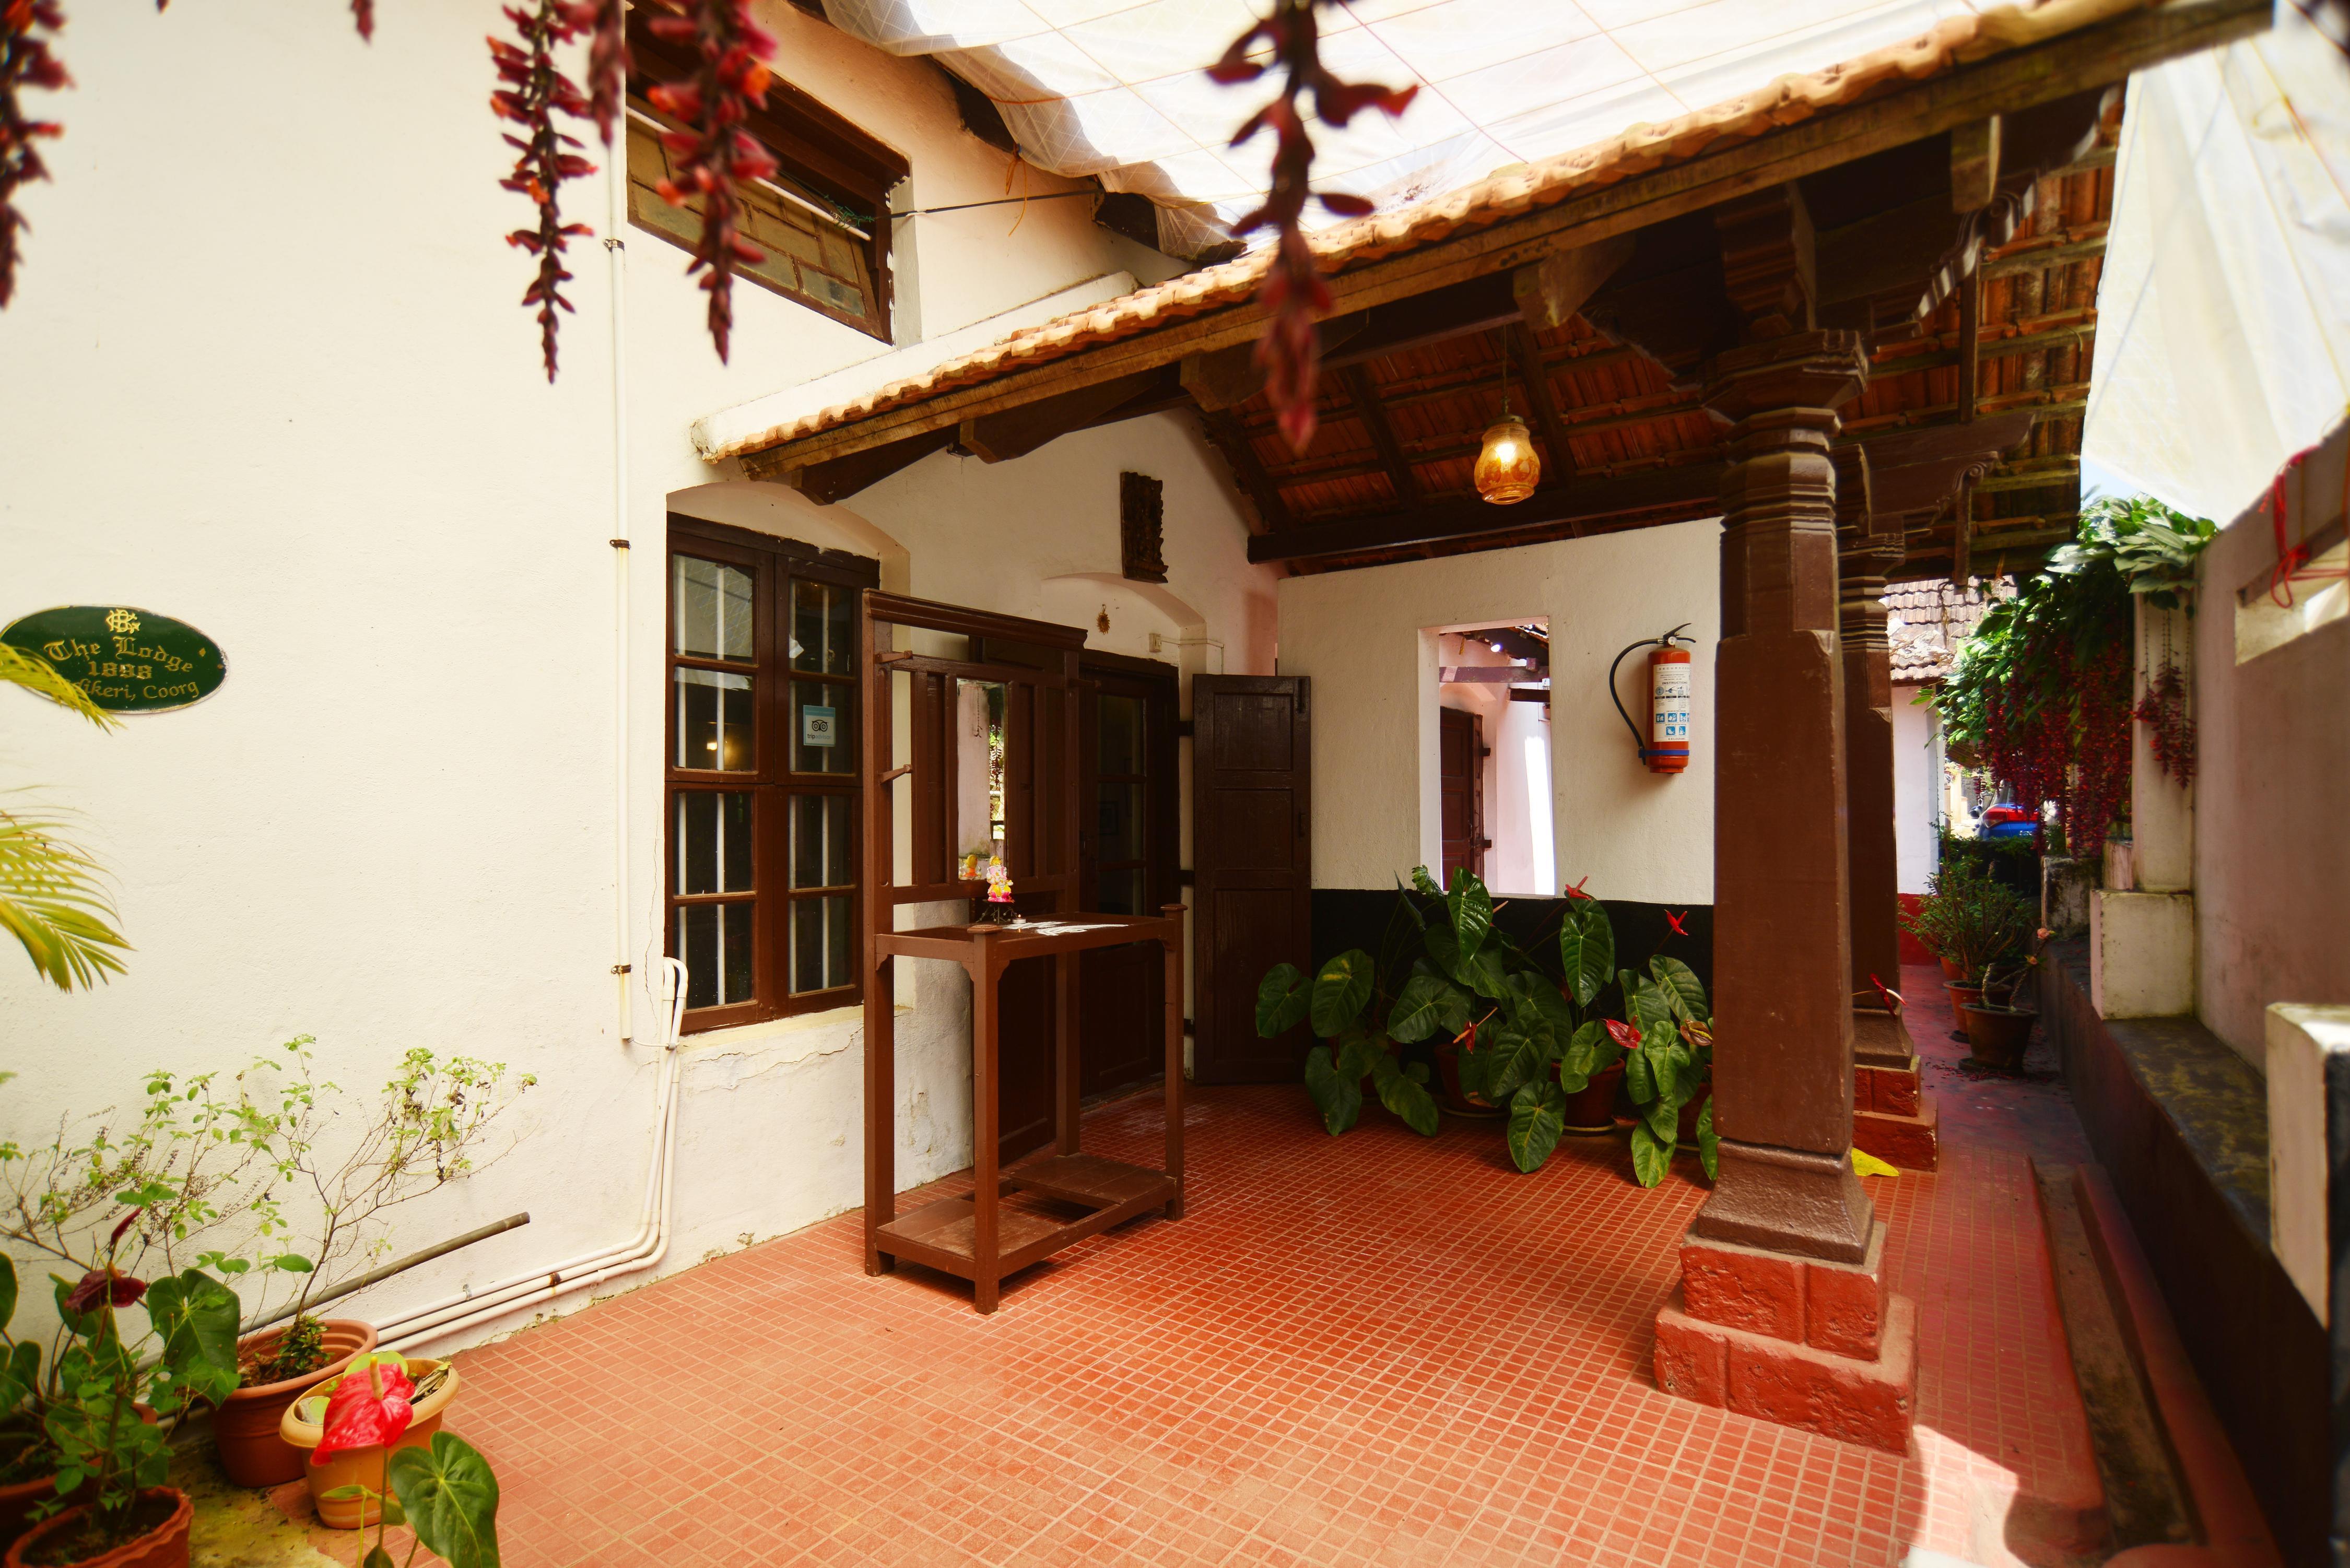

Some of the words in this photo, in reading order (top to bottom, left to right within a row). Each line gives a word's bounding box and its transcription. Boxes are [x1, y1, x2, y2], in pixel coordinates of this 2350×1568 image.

[43, 639, 101, 661] The
[112, 635, 194, 673] Lodge
[88, 661, 152, 679] 1898
[143, 681, 200, 699] Coorg
